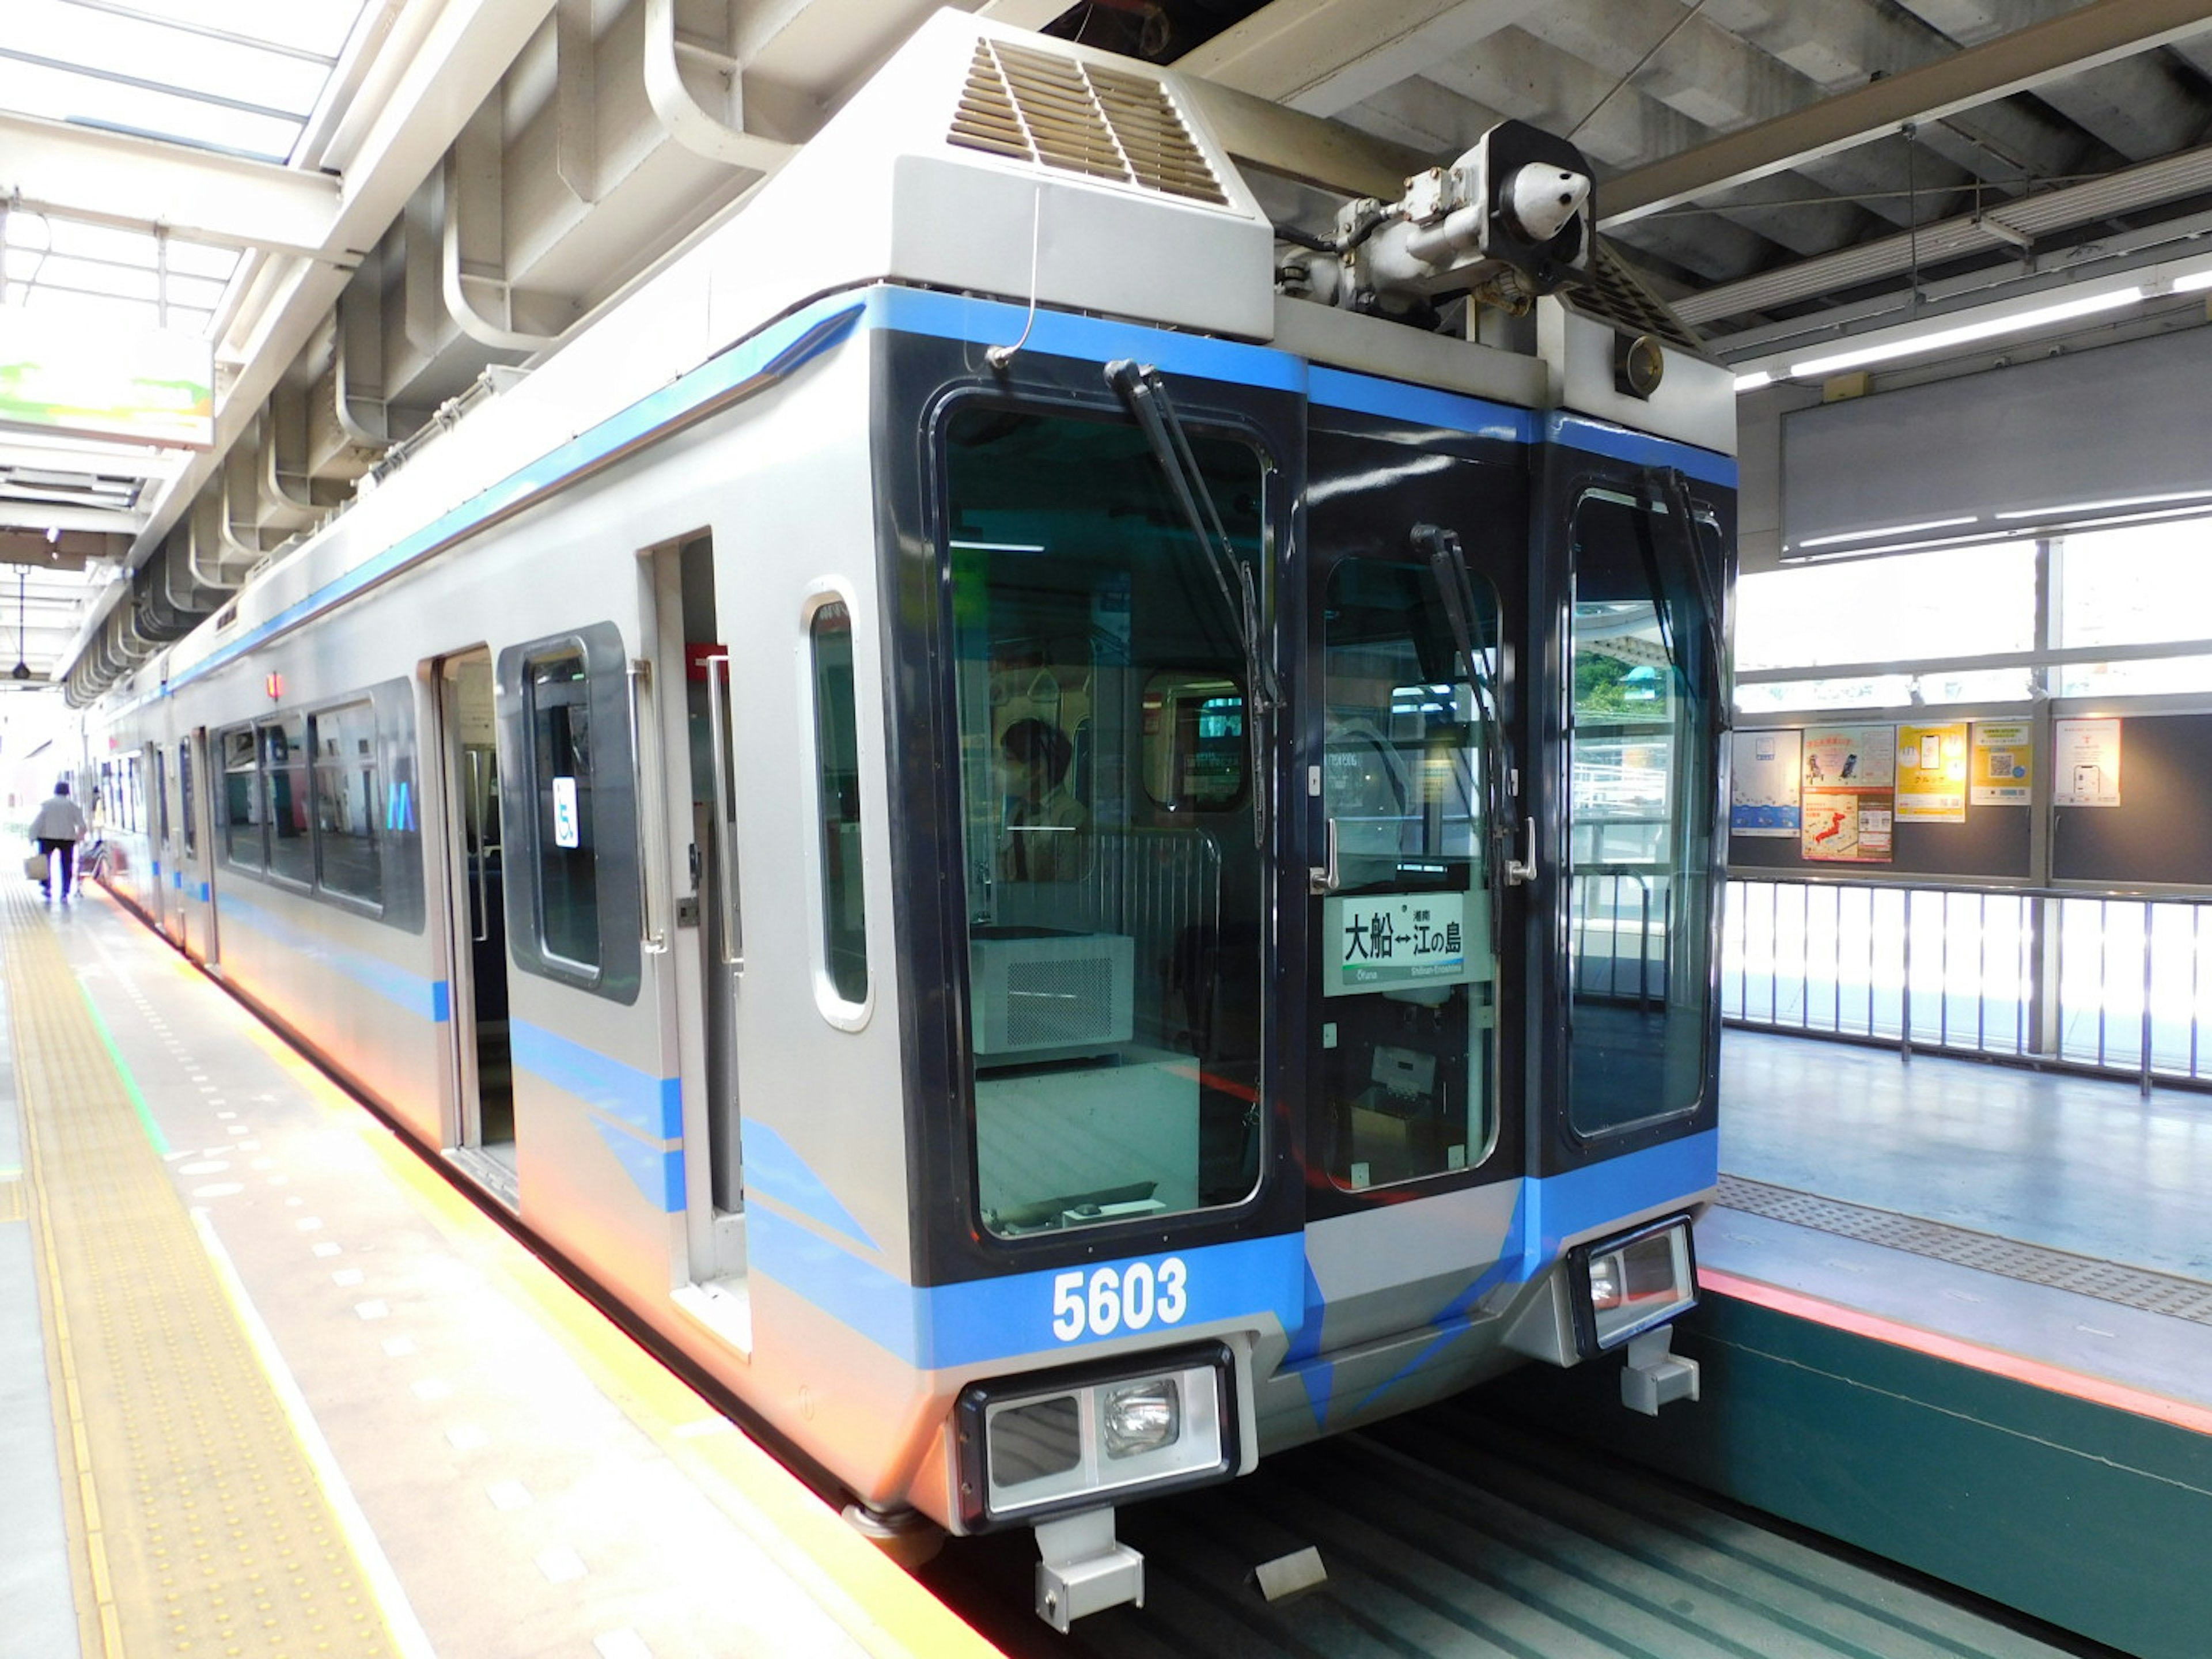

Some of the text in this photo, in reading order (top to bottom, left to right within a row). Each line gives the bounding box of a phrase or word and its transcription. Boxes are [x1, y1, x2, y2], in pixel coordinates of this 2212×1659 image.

[1345, 912, 1461, 960] 大船 江の島
[1413, 910, 1430, 922] 湘南
[1053, 1257, 1187, 1342] 5603
